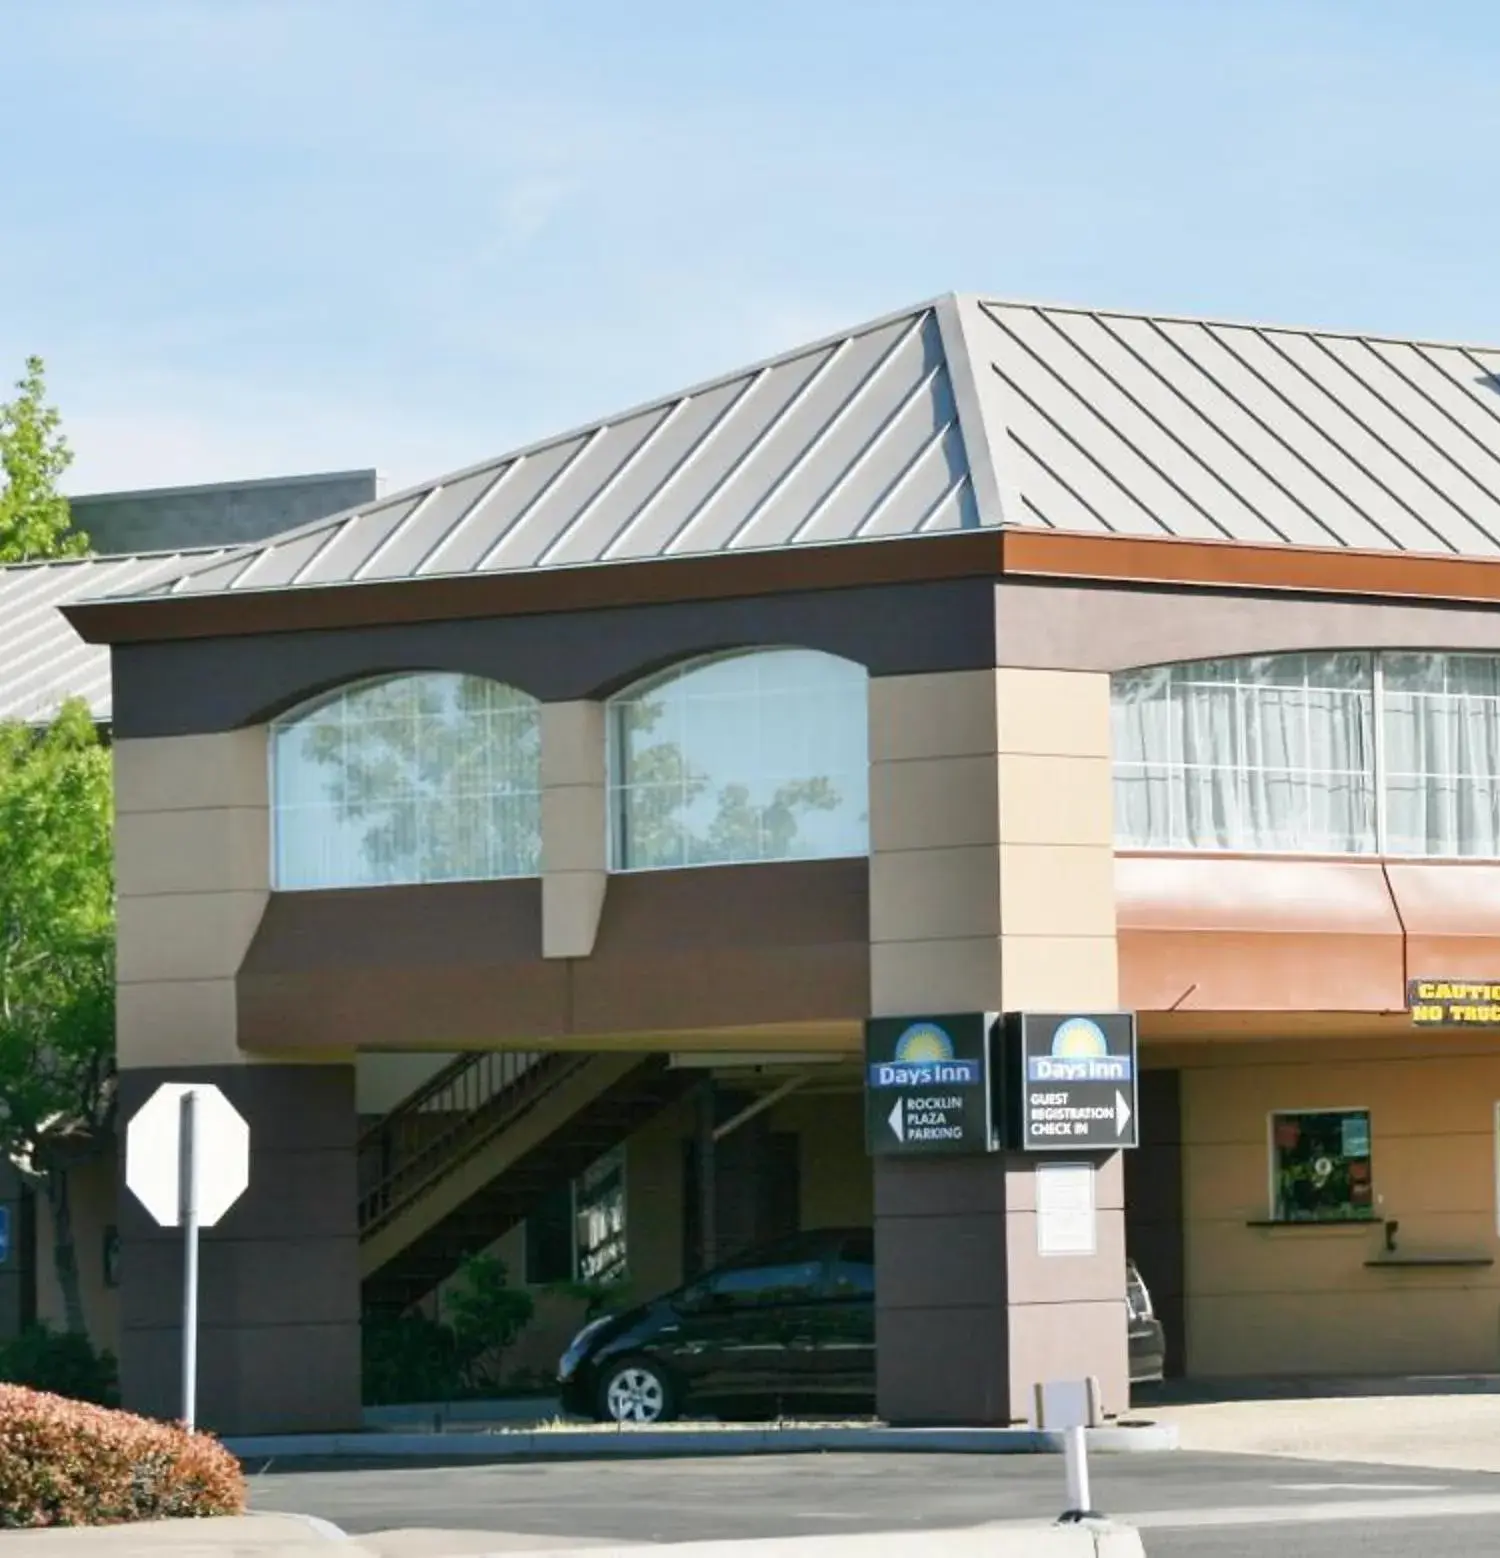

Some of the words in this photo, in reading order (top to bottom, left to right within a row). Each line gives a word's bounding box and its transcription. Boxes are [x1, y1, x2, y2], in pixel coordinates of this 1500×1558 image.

[1412, 1005, 1443, 1021] NO
[879, 1066, 931, 1086] Days
[935, 1064, 970, 1082] Inn
[1037, 1061, 1087, 1081] Days
[1090, 1060, 1123, 1079] Inn
[907, 1096, 962, 1110] ROCKLIN
[1031, 1092, 1069, 1105] GUEST
[907, 1112, 946, 1125] PLAZA
[1031, 1107, 1115, 1121] REGISTRATION
[907, 1126, 963, 1140] PARKING
[1031, 1123, 1072, 1136] CHECK
[1074, 1122, 1089, 1135] IN
